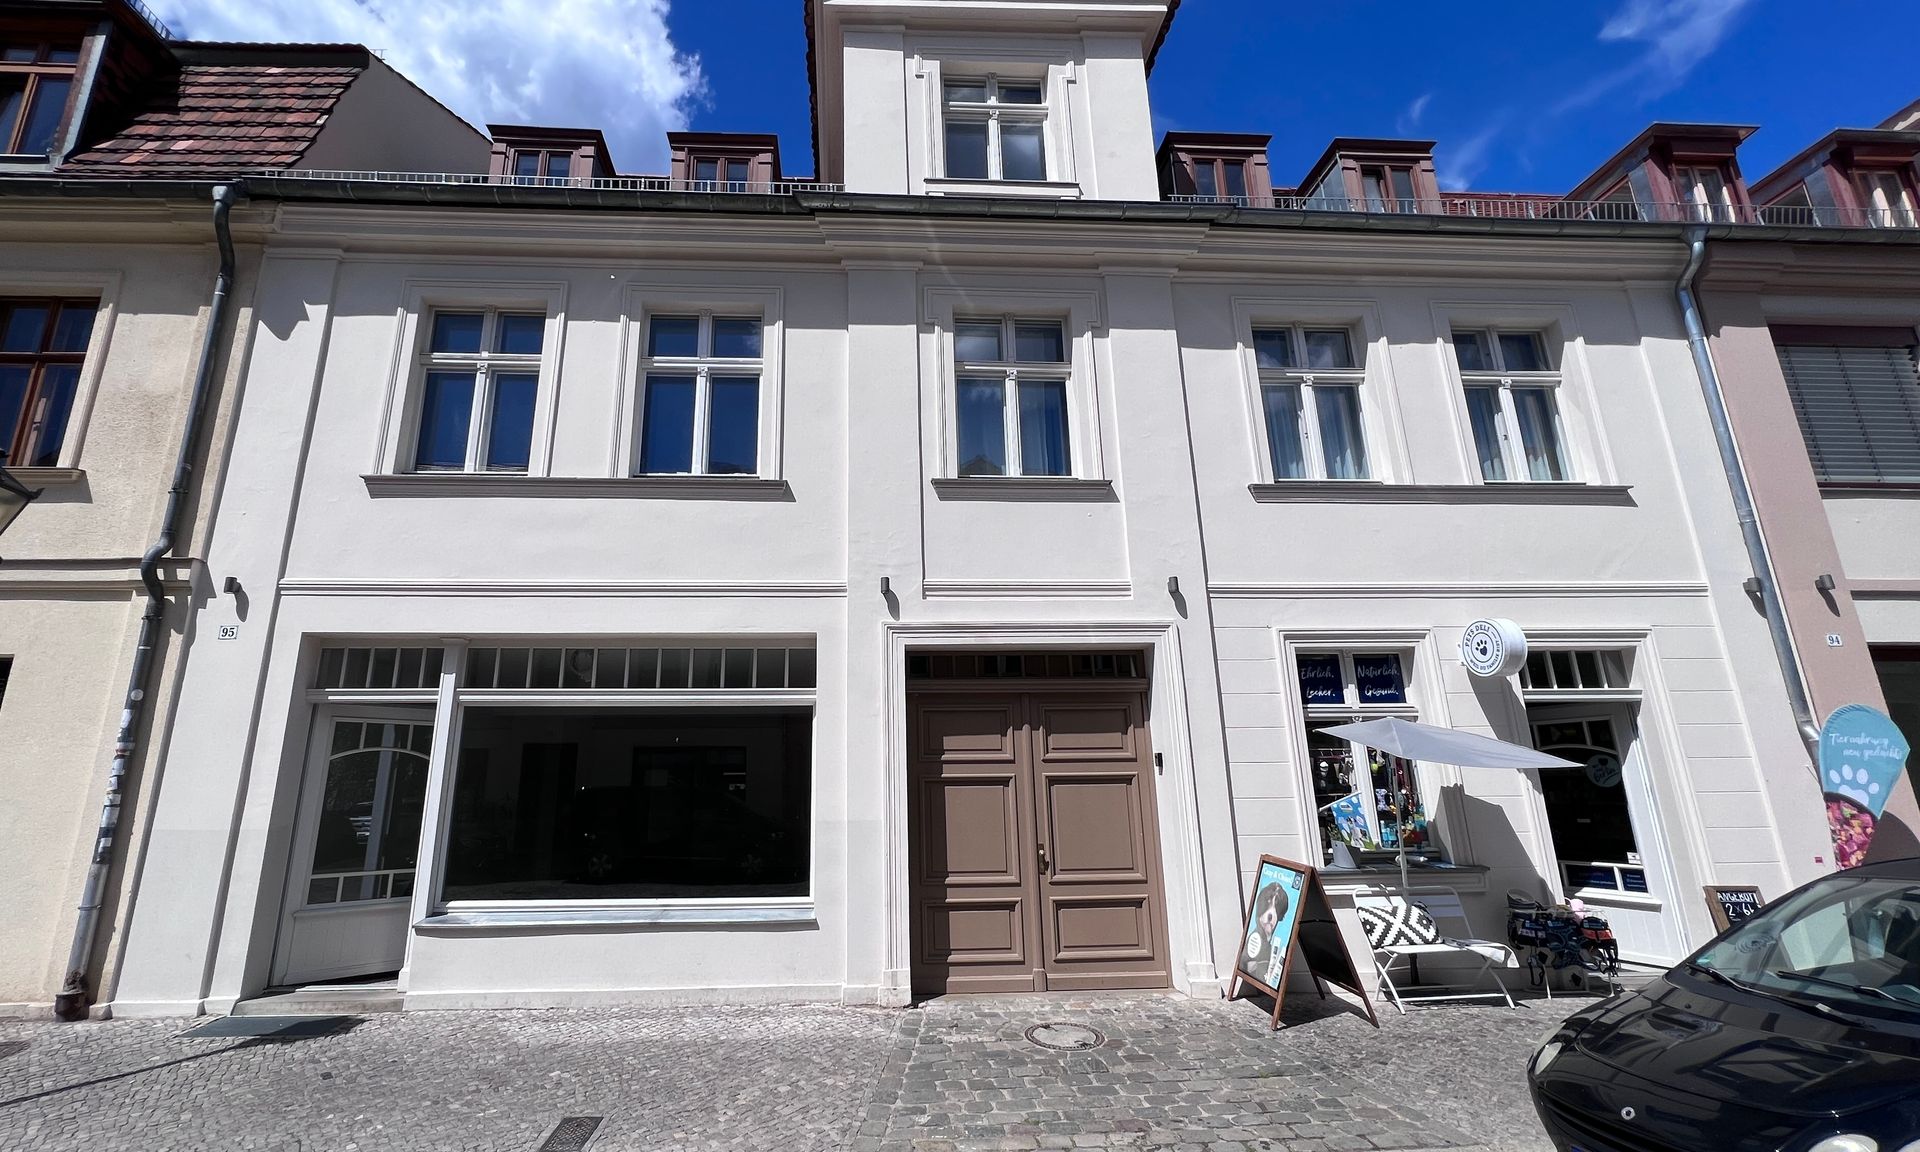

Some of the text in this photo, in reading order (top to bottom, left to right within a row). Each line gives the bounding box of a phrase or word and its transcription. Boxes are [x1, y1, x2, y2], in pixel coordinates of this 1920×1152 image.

[221, 627, 235, 638] 95
[1465, 624, 1490, 648] PETS DELI
[1828, 635, 1840, 645] 94
[1725, 902, 1736, 917] 2
